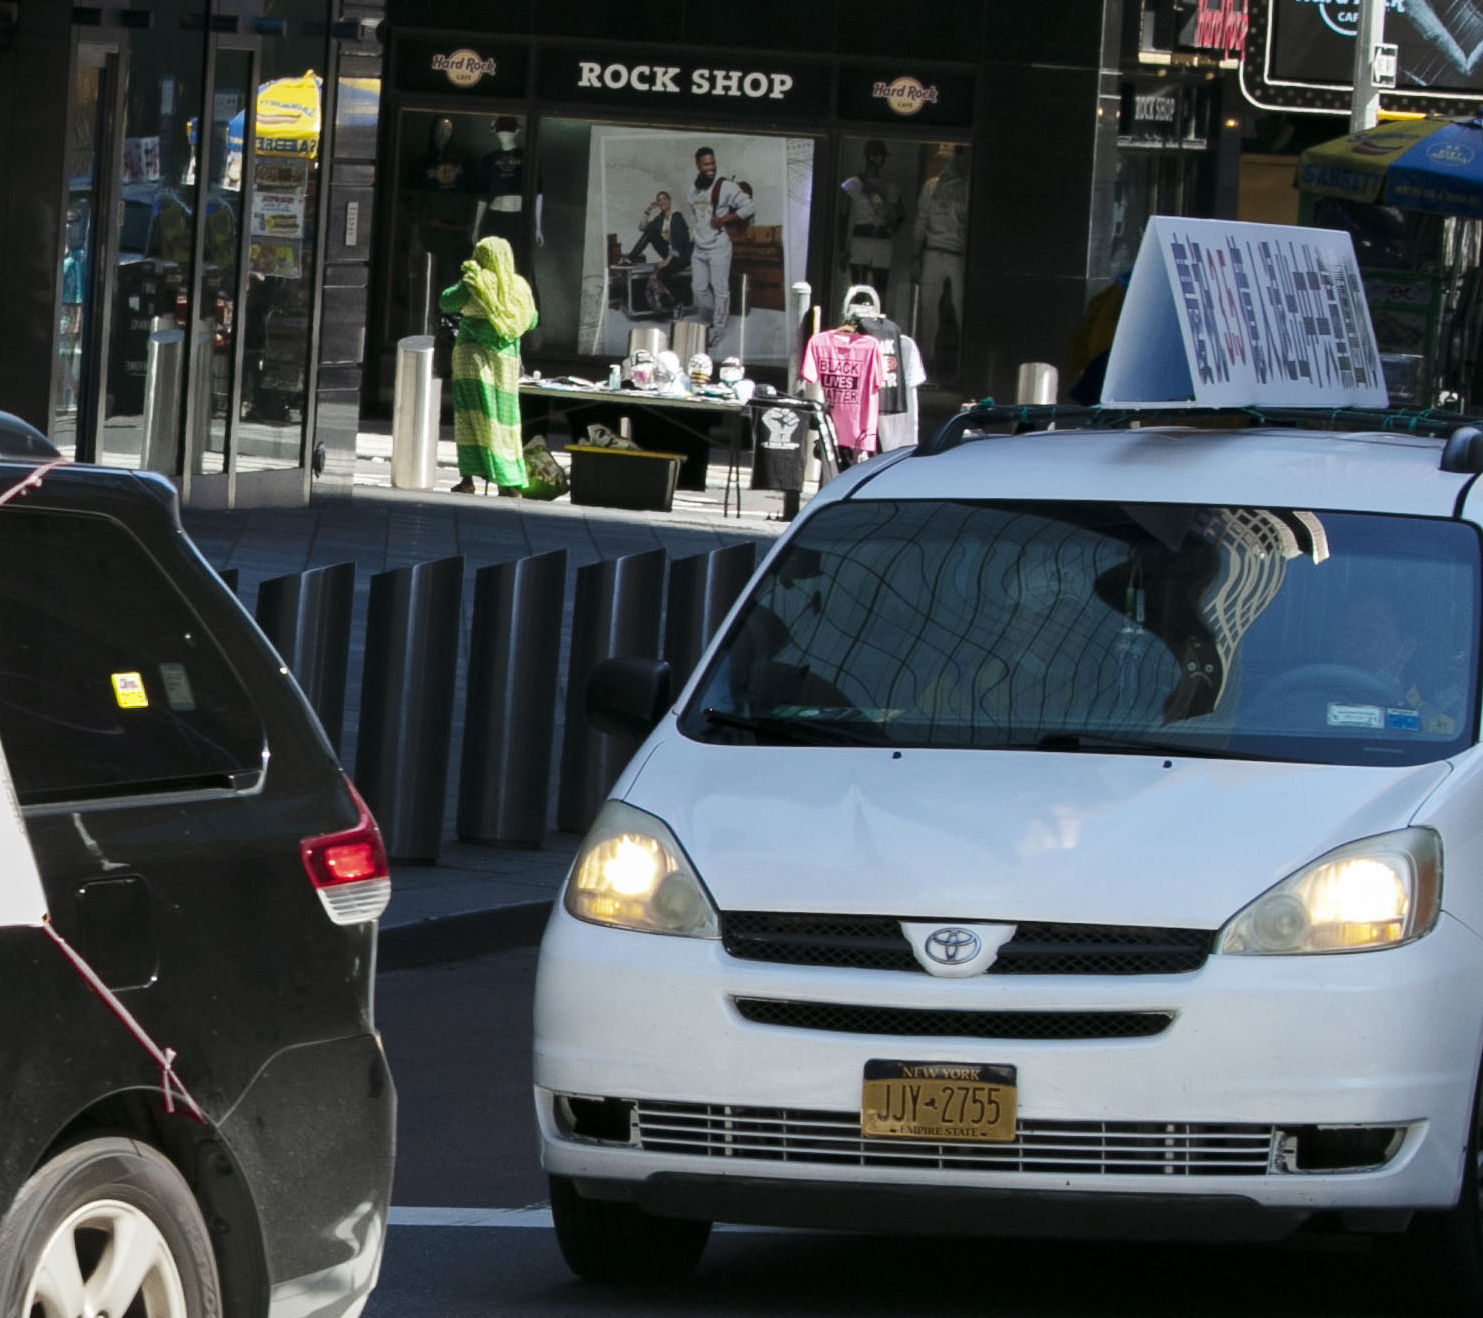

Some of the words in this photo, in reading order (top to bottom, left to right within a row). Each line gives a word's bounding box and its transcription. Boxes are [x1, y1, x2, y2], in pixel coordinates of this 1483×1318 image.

[1337, 10, 1360, 24] CAF
[433, 53, 465, 72] Hard
[463, 56, 496, 77] Rock
[578, 61, 681, 93] ROCK
[691, 68, 794, 100] SHOP
[872, 82, 907, 98] Hard
[905, 84, 938, 104] Rock
[1134, 95, 1154, 121] ROCK
[1154, 97, 1176, 122] SHOP
[819, 359, 860, 375] BLACK
[823, 376, 854, 389] LIVES
[902, 1065, 940, 1080] NEW
[941, 1066, 982, 1082] YORK
[876, 1083, 922, 1123] JJY
[940, 1086, 1002, 1126] 2755
[900, 1125, 943, 1137] EMPIRE
[944, 1127, 979, 1139] STATE
